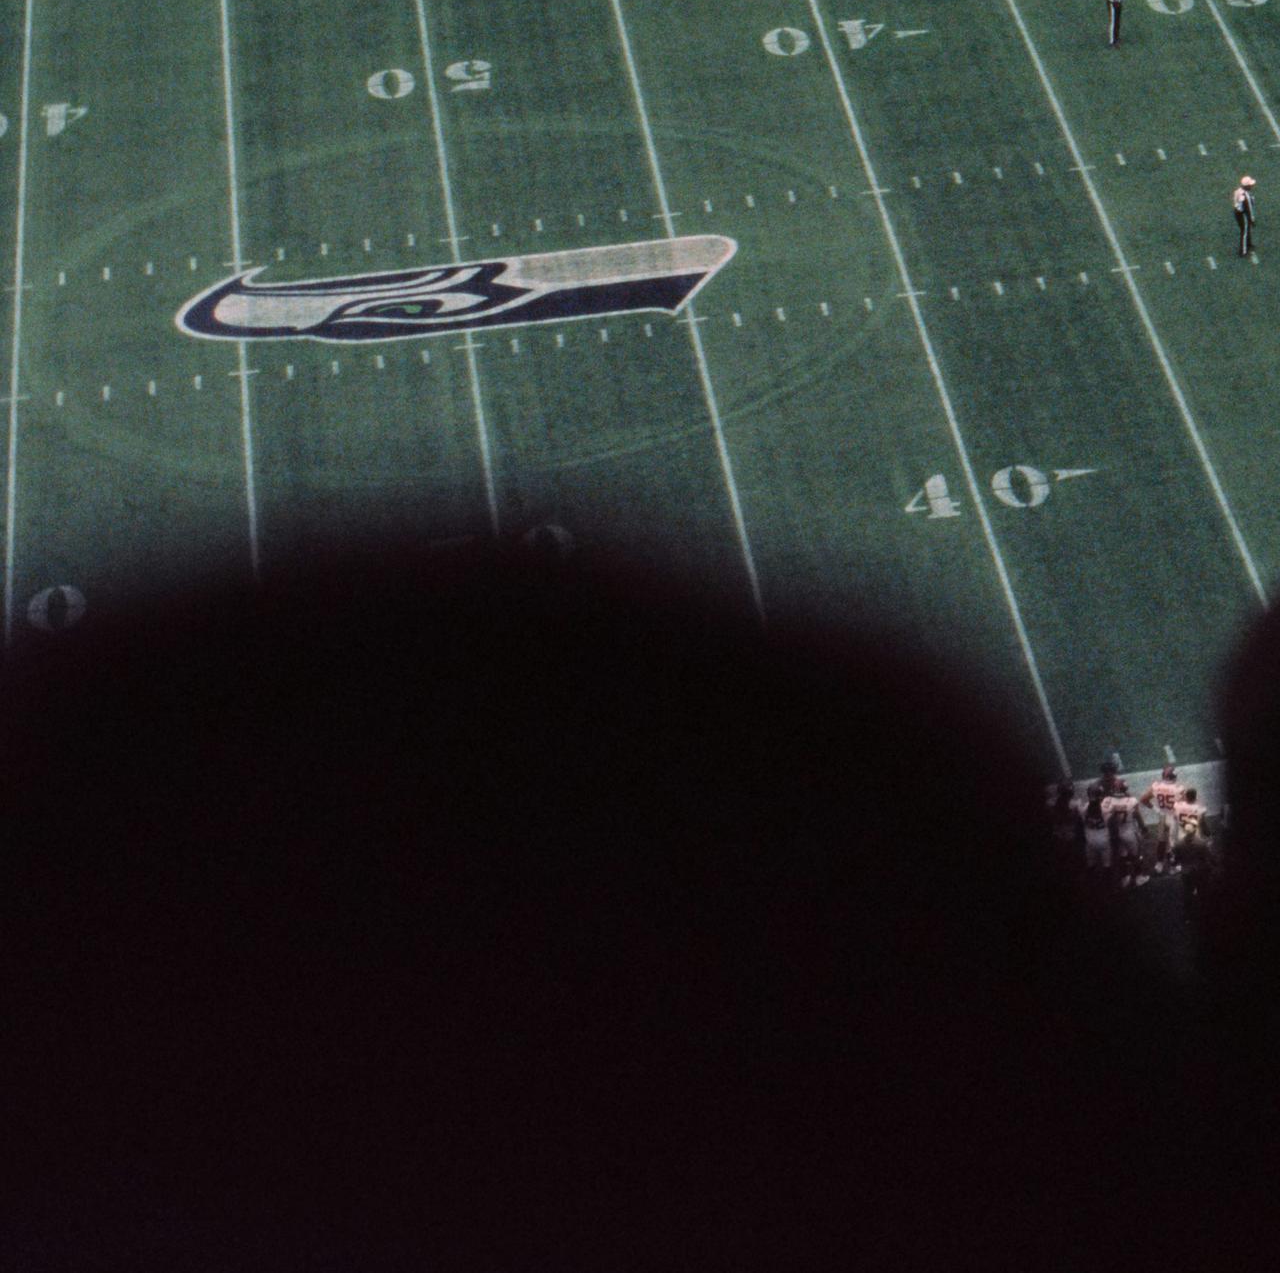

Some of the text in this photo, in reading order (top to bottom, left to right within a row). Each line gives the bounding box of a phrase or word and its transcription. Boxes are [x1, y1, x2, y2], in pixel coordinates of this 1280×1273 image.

[762, 18, 886, 58] 40
[366, 59, 492, 101] 50
[905, 463, 1051, 520] 40
[1157, 793, 1175, 810] 85
